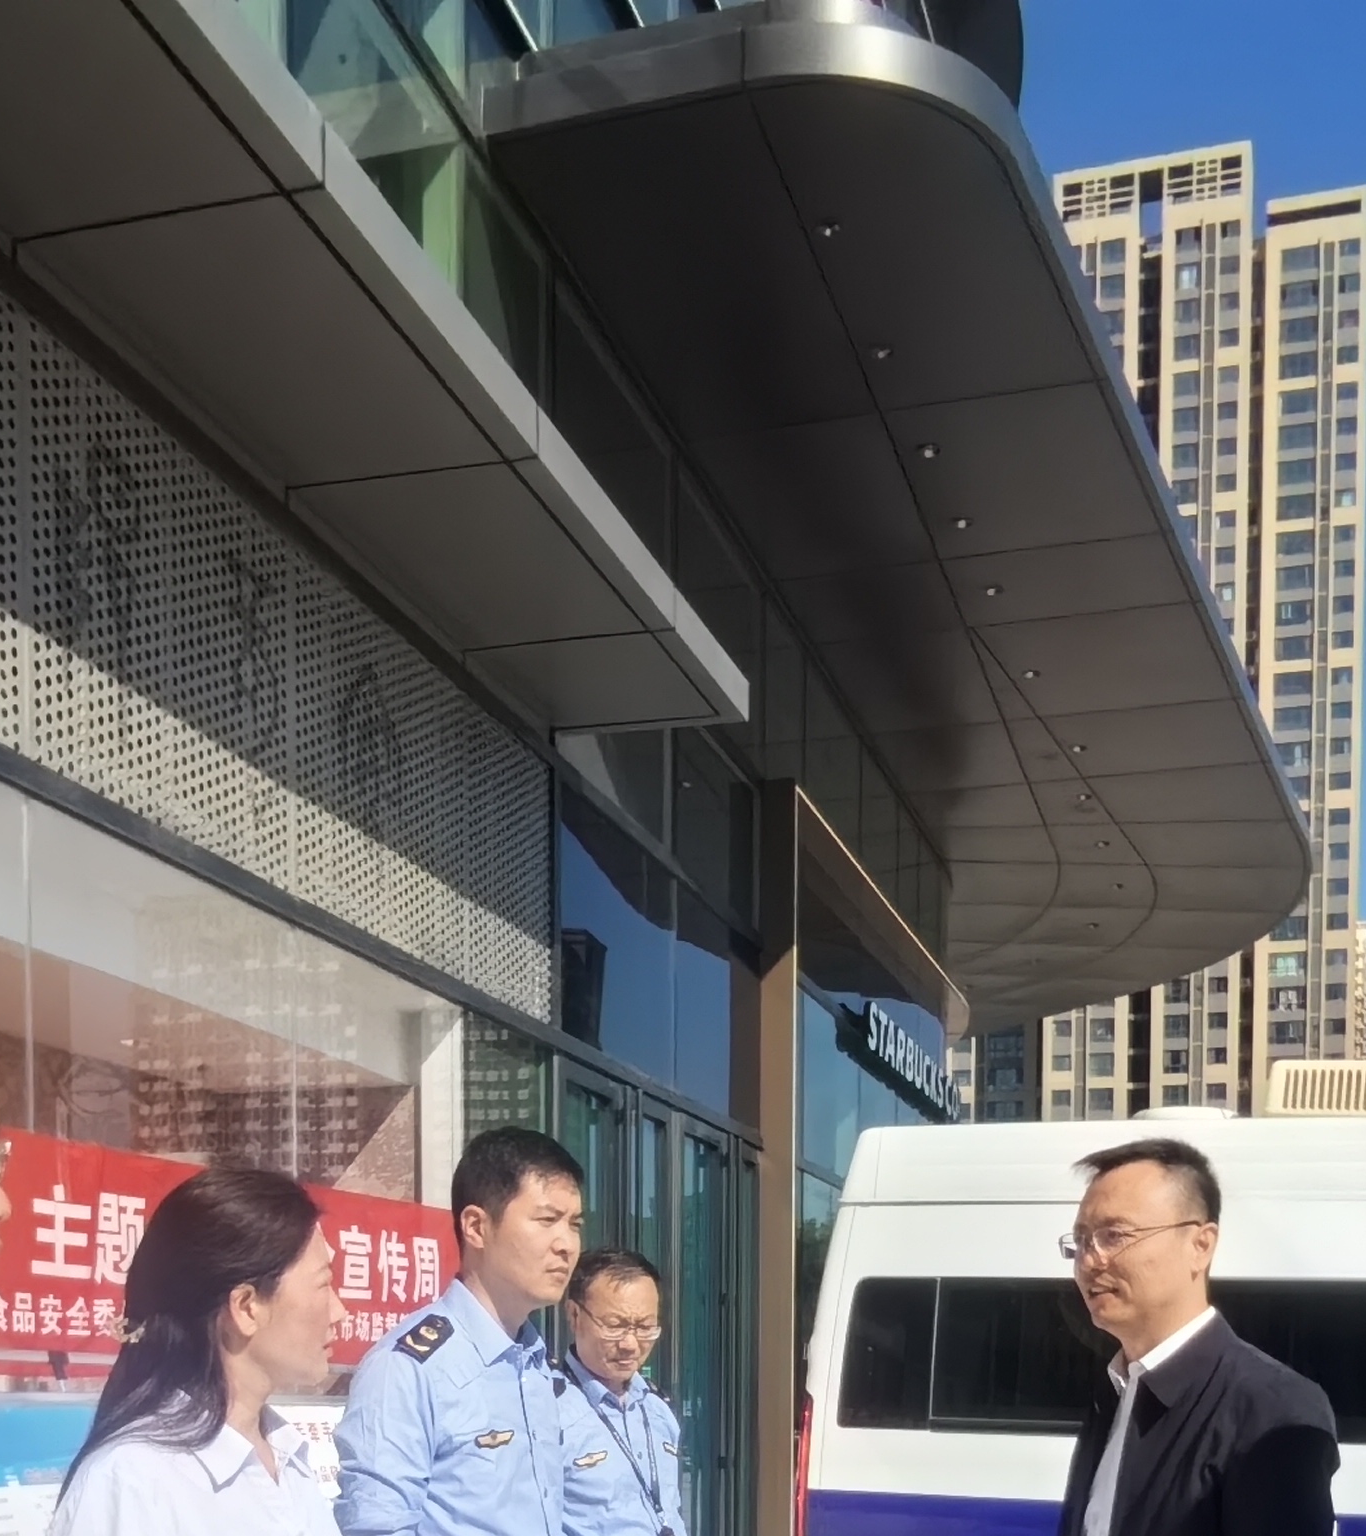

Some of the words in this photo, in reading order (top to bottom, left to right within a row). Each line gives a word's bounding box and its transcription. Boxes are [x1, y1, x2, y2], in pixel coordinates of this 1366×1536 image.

[867, 1001, 944, 1109] STARBUCKS
[31, 1184, 146, 1285] 主题
[319, 1222, 441, 1303] 宣传周
[331, 1310, 413, 1342] 市场监督
